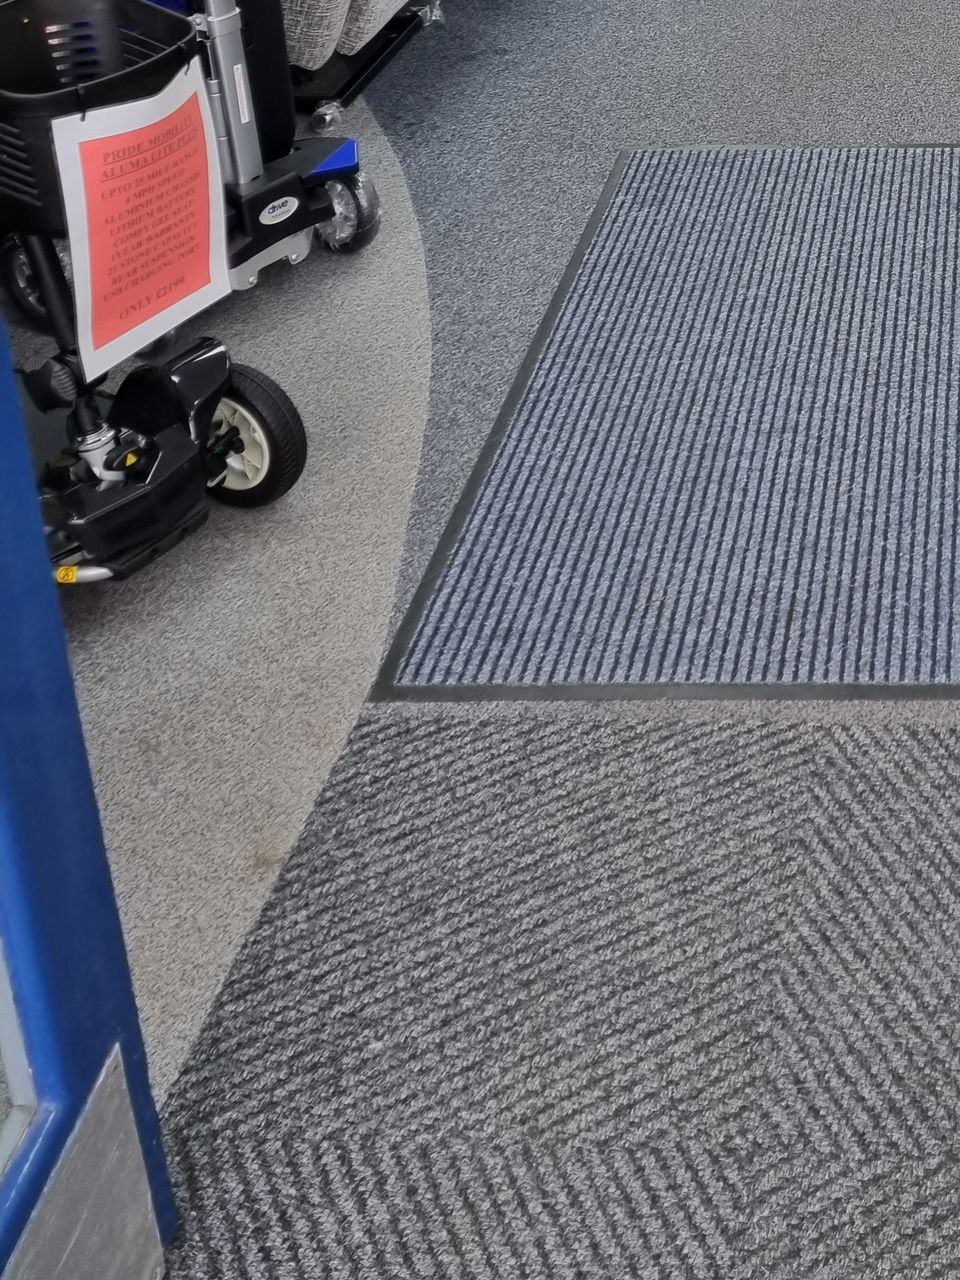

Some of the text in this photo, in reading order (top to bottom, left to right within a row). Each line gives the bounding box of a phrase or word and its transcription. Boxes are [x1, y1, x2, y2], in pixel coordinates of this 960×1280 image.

[102, 142, 144, 164] PRIDE
[133, 185, 155, 200] MPH
[157, 167, 185, 187] SPEED
[156, 186, 195, 214] BATTERY
[119, 294, 153, 321] ONLY
